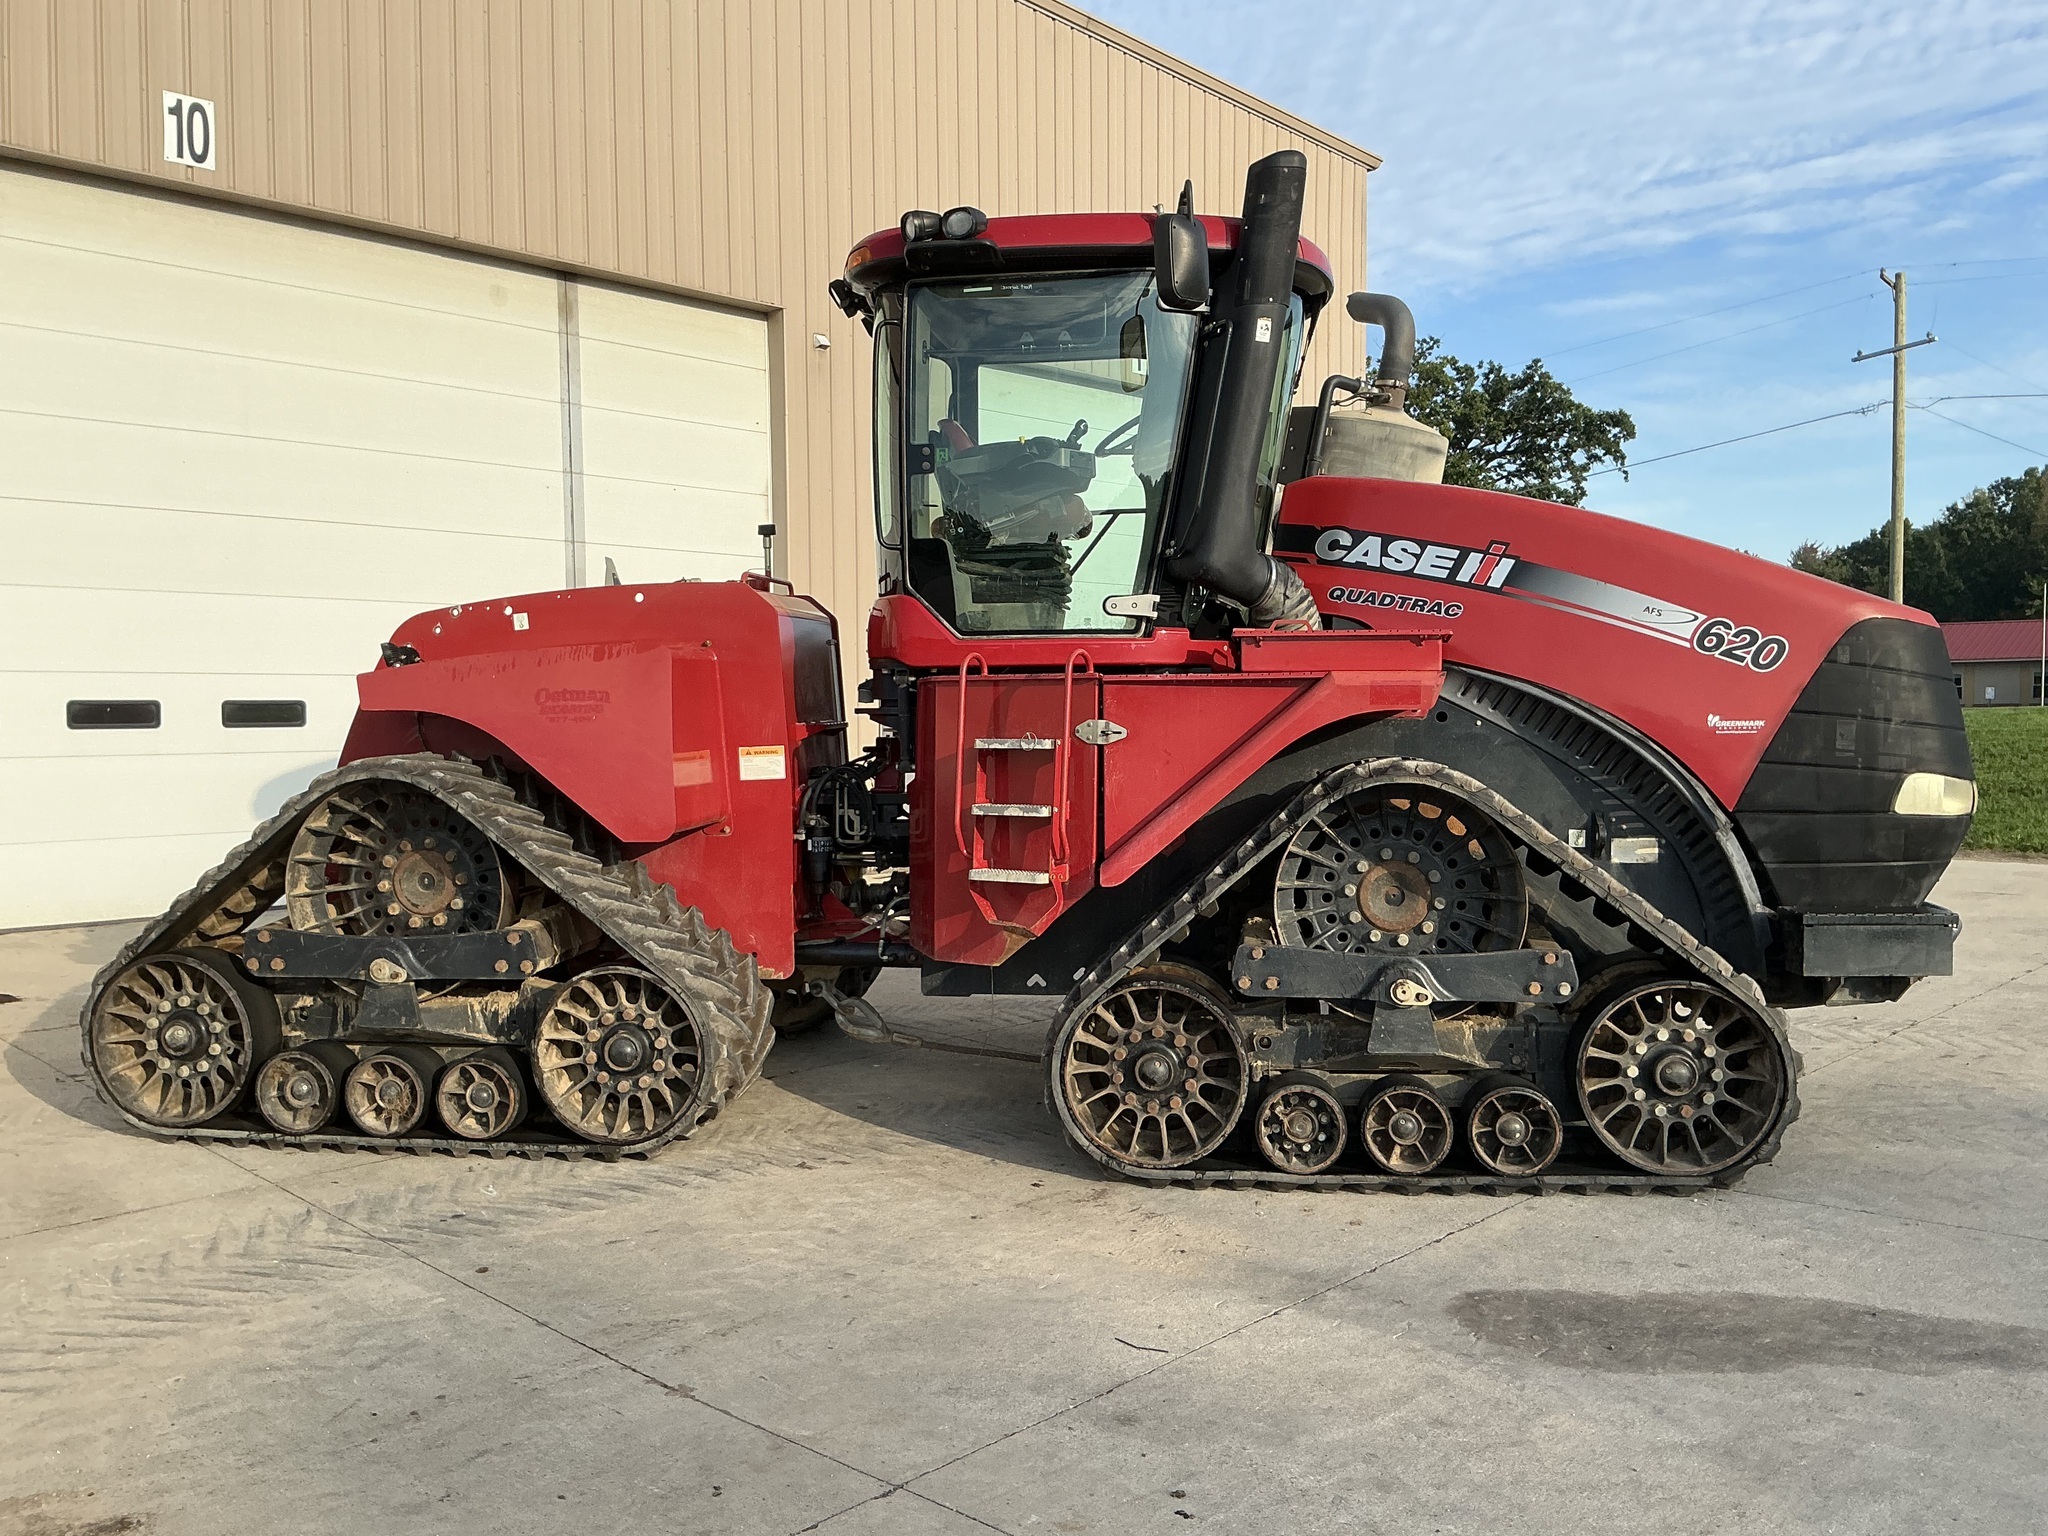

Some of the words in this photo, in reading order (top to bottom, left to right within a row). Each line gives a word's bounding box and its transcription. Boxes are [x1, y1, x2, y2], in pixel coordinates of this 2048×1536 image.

[167, 98, 210, 164] 10
[1315, 529, 1460, 579] CASE
[1328, 585, 1463, 618] QUADTRAC
[1643, 605, 1663, 617] AFS
[1693, 617, 1789, 673] 620
[1715, 719, 1766, 727] GREENMARK
